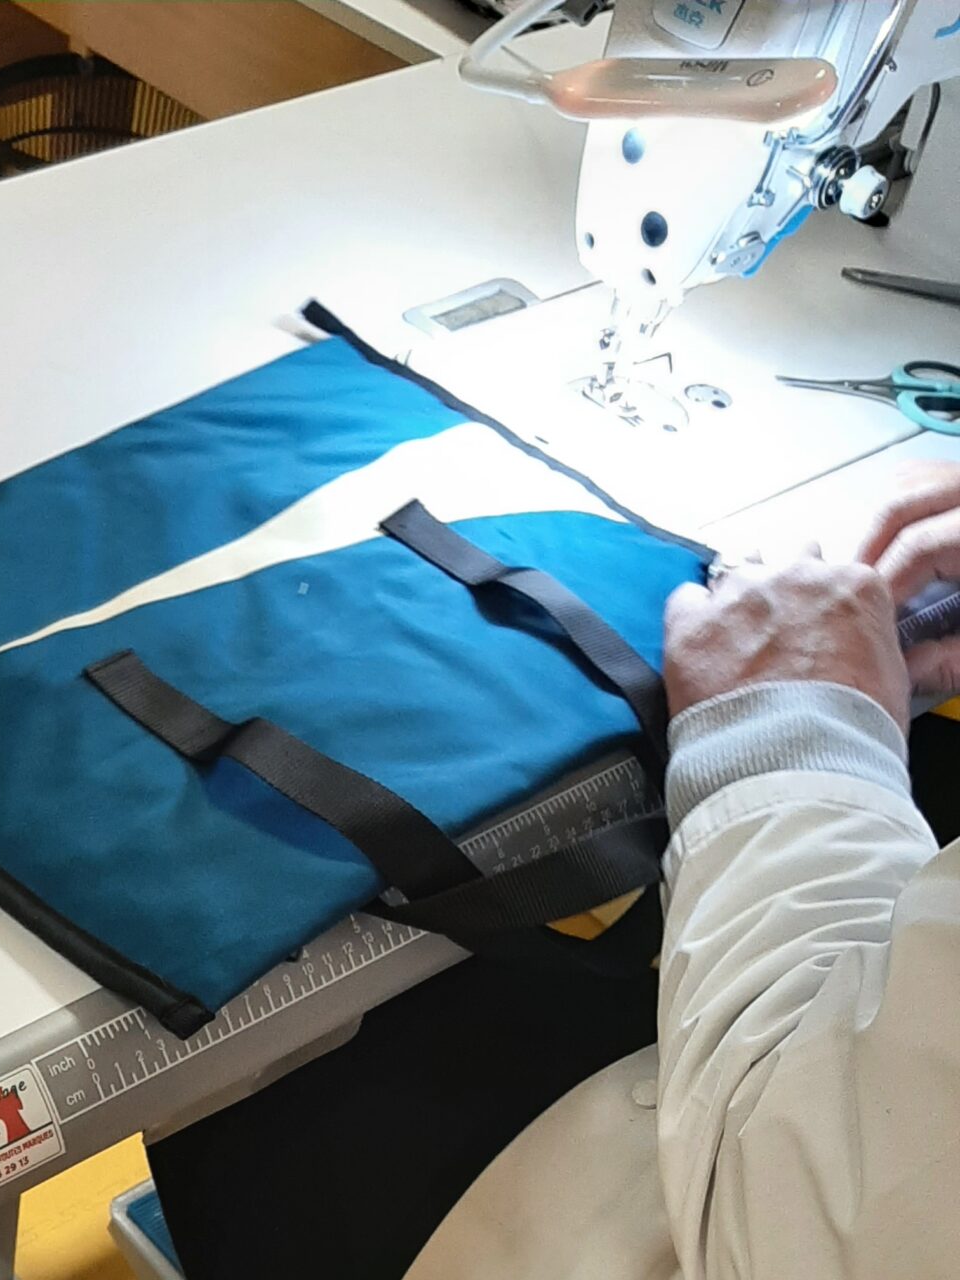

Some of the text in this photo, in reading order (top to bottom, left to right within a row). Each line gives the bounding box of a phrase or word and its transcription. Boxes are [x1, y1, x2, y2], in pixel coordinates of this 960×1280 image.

[135, 1049, 145, 1063] 2
[156, 1038, 166, 1051] 3
[301, 962, 316, 977] 10
[321, 951, 334, 966] 11
[342, 941, 355, 955] 12
[361, 930, 375, 945] 13
[47, 1055, 77, 1078] inch
[86, 1058, 96, 1071] 0
[66, 1089, 86, 1106] cm
[22, 1129, 55, 1151] MARQUES
[4, 1162, 18, 1176] 29
